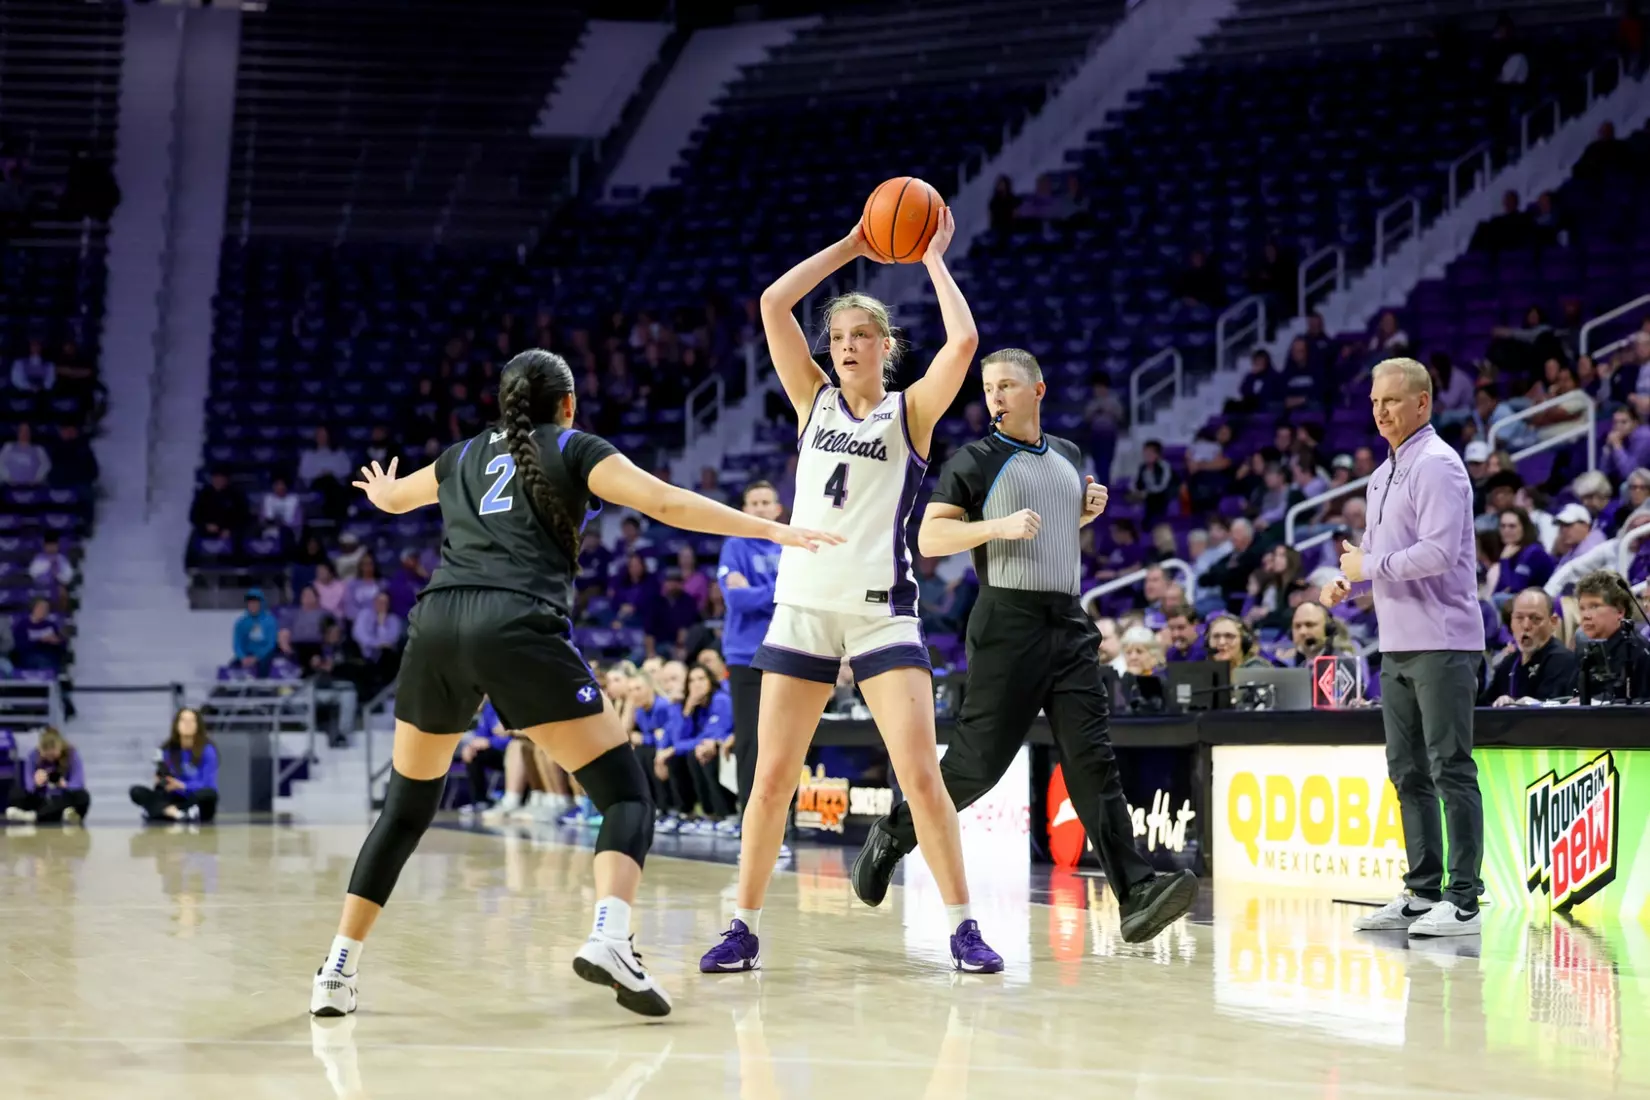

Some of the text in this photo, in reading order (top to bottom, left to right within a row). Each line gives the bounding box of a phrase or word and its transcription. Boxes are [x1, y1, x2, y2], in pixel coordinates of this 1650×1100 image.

[811, 425, 888, 461] Wildcats
[479, 453, 517, 515] 2
[823, 462, 850, 509] 4
[1146, 788, 1196, 852] Hut
[1227, 771, 1407, 867] QDOBA
[1264, 850, 1409, 881] MEXICAN EATS
